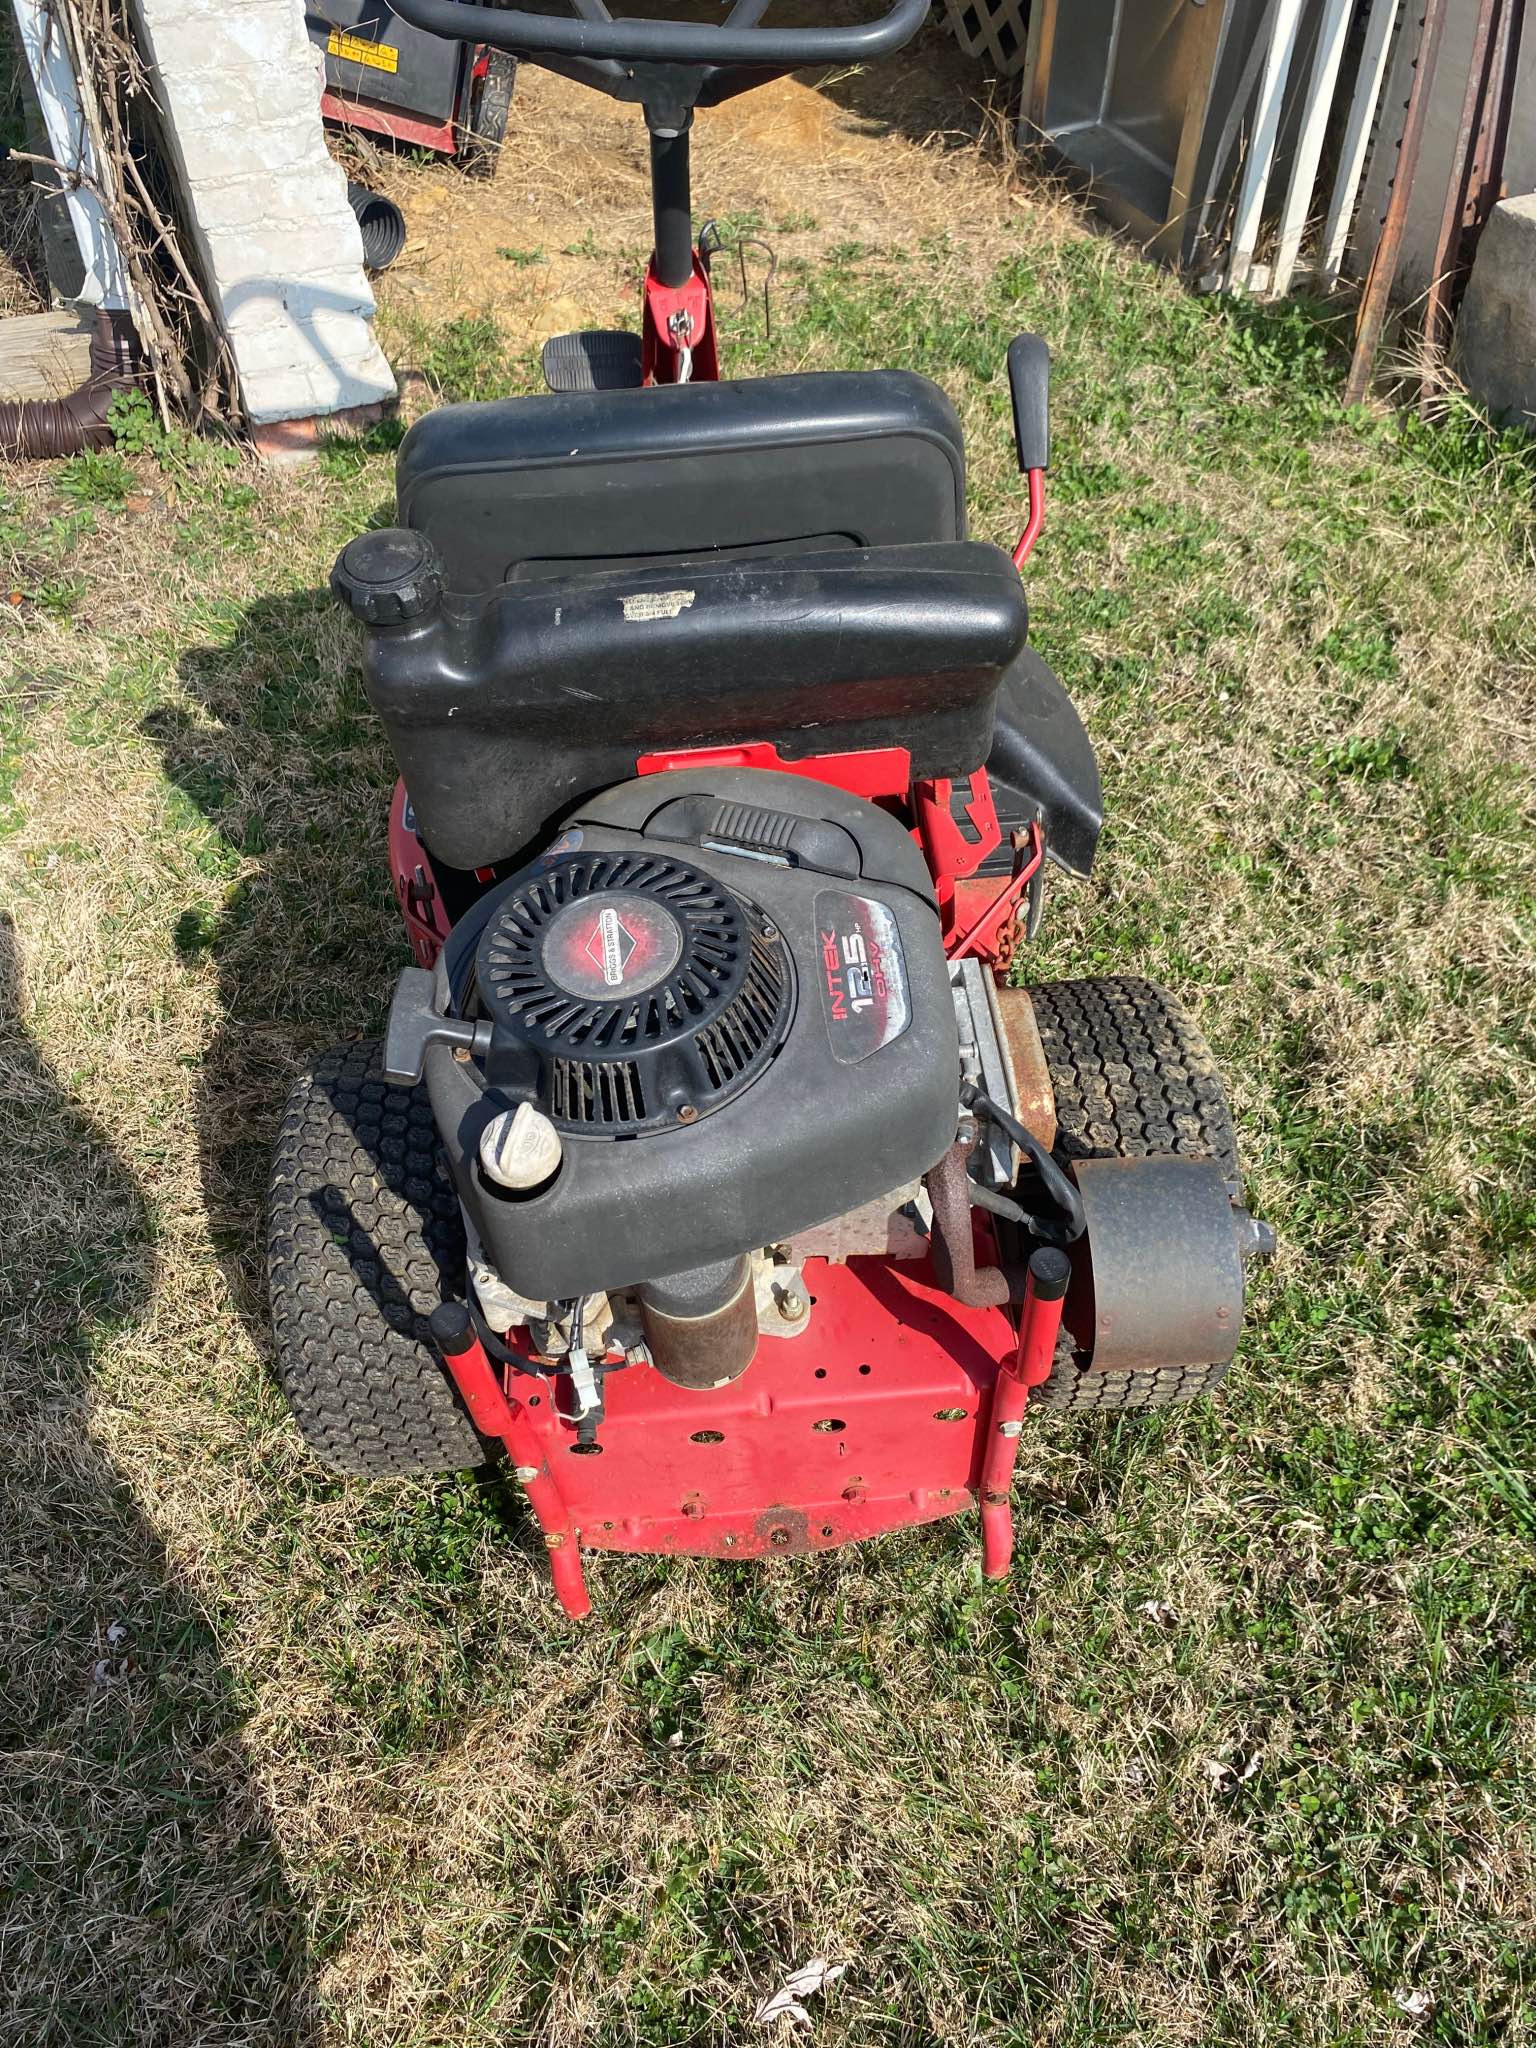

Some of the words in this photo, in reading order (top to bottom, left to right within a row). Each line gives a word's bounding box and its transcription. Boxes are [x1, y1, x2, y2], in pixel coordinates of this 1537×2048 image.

[604, 912, 615, 947] STRATTON
[609, 954, 618, 981] BRIGGS
[820, 928, 848, 1021] INTEK
[869, 941, 888, 997] OHV
